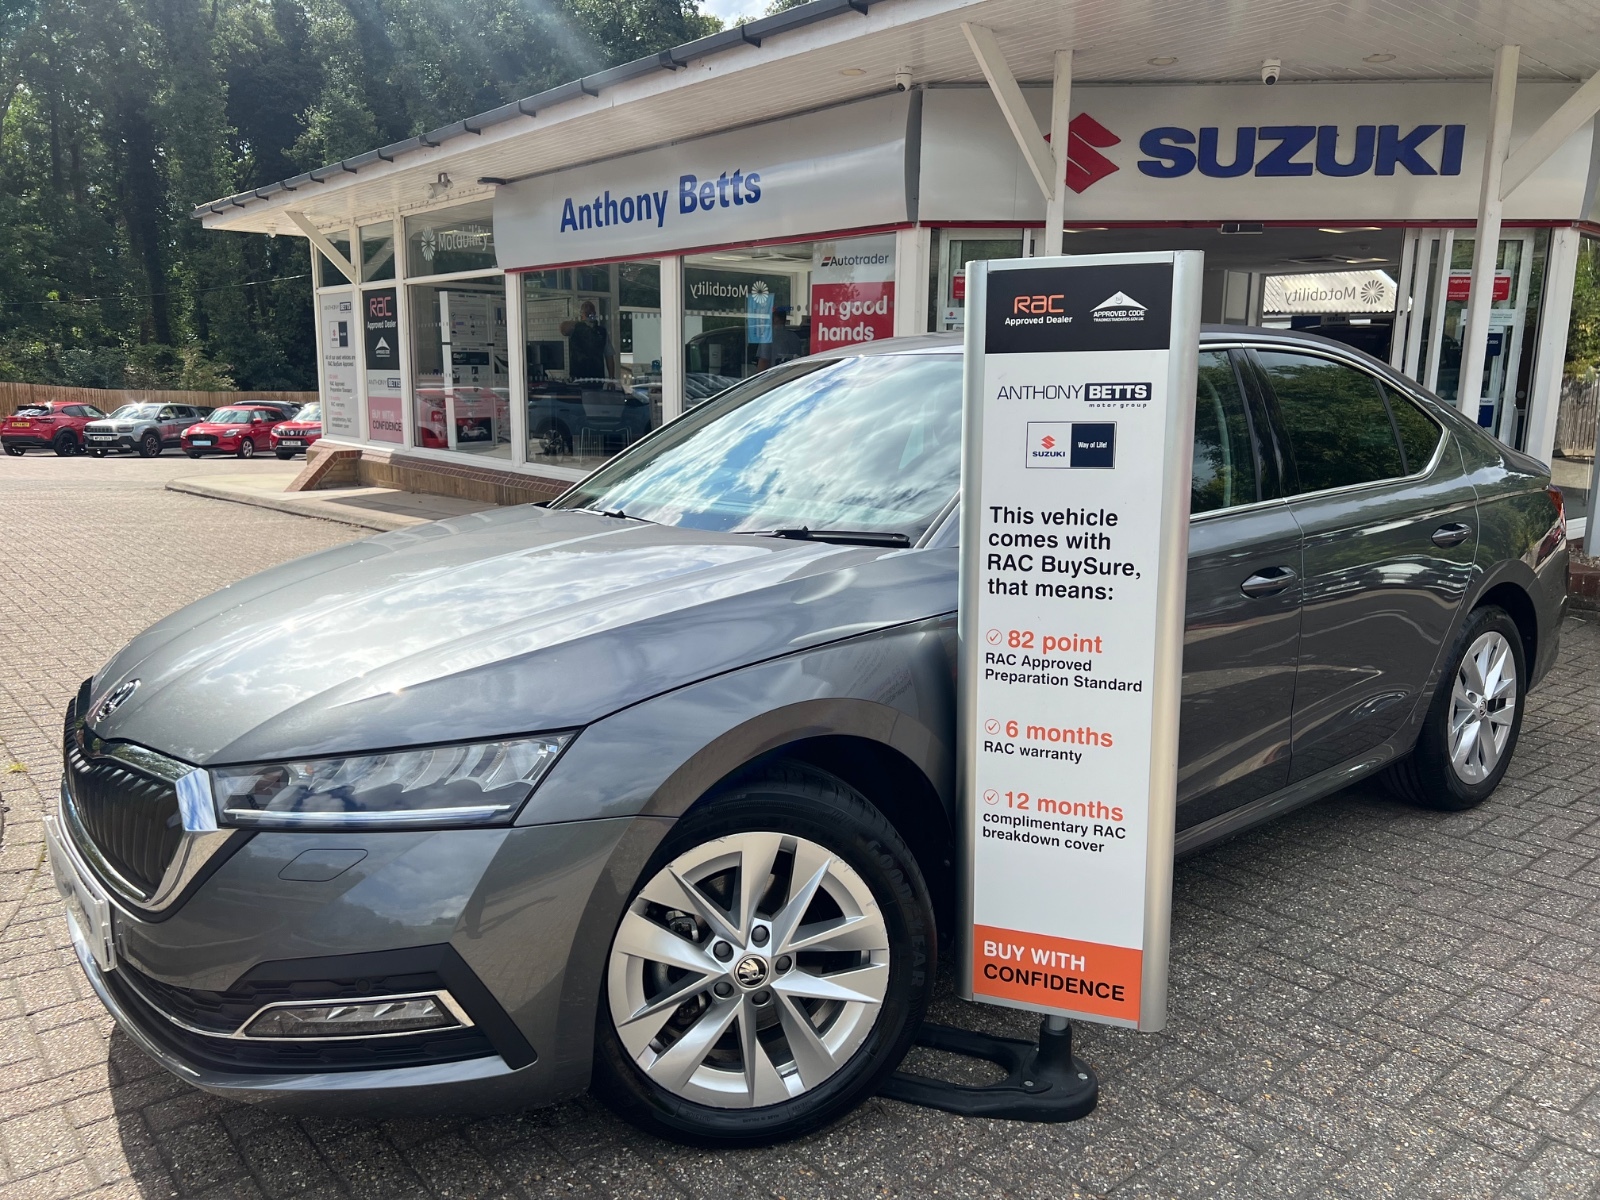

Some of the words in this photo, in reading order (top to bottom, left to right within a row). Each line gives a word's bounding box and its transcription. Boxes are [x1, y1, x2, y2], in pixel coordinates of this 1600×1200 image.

[1137, 125, 1466, 178] SUZUKI
[560, 189, 669, 233] Anthony
[679, 168, 762, 215] Betts
[438, 225, 489, 252] Motability
[829, 253, 890, 267] Autotrader
[819, 298, 836, 317] In
[839, 295, 888, 320] good
[1093, 310, 1127, 318] APPROVED
[367, 321, 384, 331] Approved
[384, 319, 397, 328] Dealer
[818, 321, 875, 342] hands
[1004, 316, 1044, 327] Approved
[1046, 315, 1073, 324] Dealer
[996, 384, 1084, 400] ANTHONY
[1088, 385, 1148, 399] BETTS
[372, 420, 402, 432] CONFIDENCE
[1078, 441, 1089, 449] Way
[1096, 441, 1108, 449] Life!
[989, 506, 1035, 525] This
[1041, 507, 1118, 527] vehicle
[988, 532, 1059, 548] comes
[1066, 532, 1111, 550] with
[987, 553, 1034, 572] RAC
[1041, 555, 1141, 580] BuySure,
[988, 578, 1028, 596] that
[1035, 582, 1113, 601] means:
[1008, 629, 1035, 649] 82
[1042, 633, 1103, 655] point
[985, 652, 1017, 666] RAC
[1021, 655, 1092, 672] Approved
[985, 668, 1069, 686] Preparation
[1074, 675, 1143, 692] Standard
[1005, 720, 1019, 738] 6
[1026, 724, 1113, 748] months
[984, 740, 1015, 755] RAC
[1019, 746, 1083, 764] warranty
[1005, 791, 1030, 810] 12
[1037, 797, 1124, 822] months
[983, 813, 1089, 837] complimentary
[1093, 824, 1126, 839] RAC
[983, 826, 1060, 847] breakdown
[1064, 838, 1105, 852] cover
[983, 940, 1025, 962] BUY
[1031, 947, 1085, 972] WITH
[983, 963, 1125, 1002] CONFIDENCE
